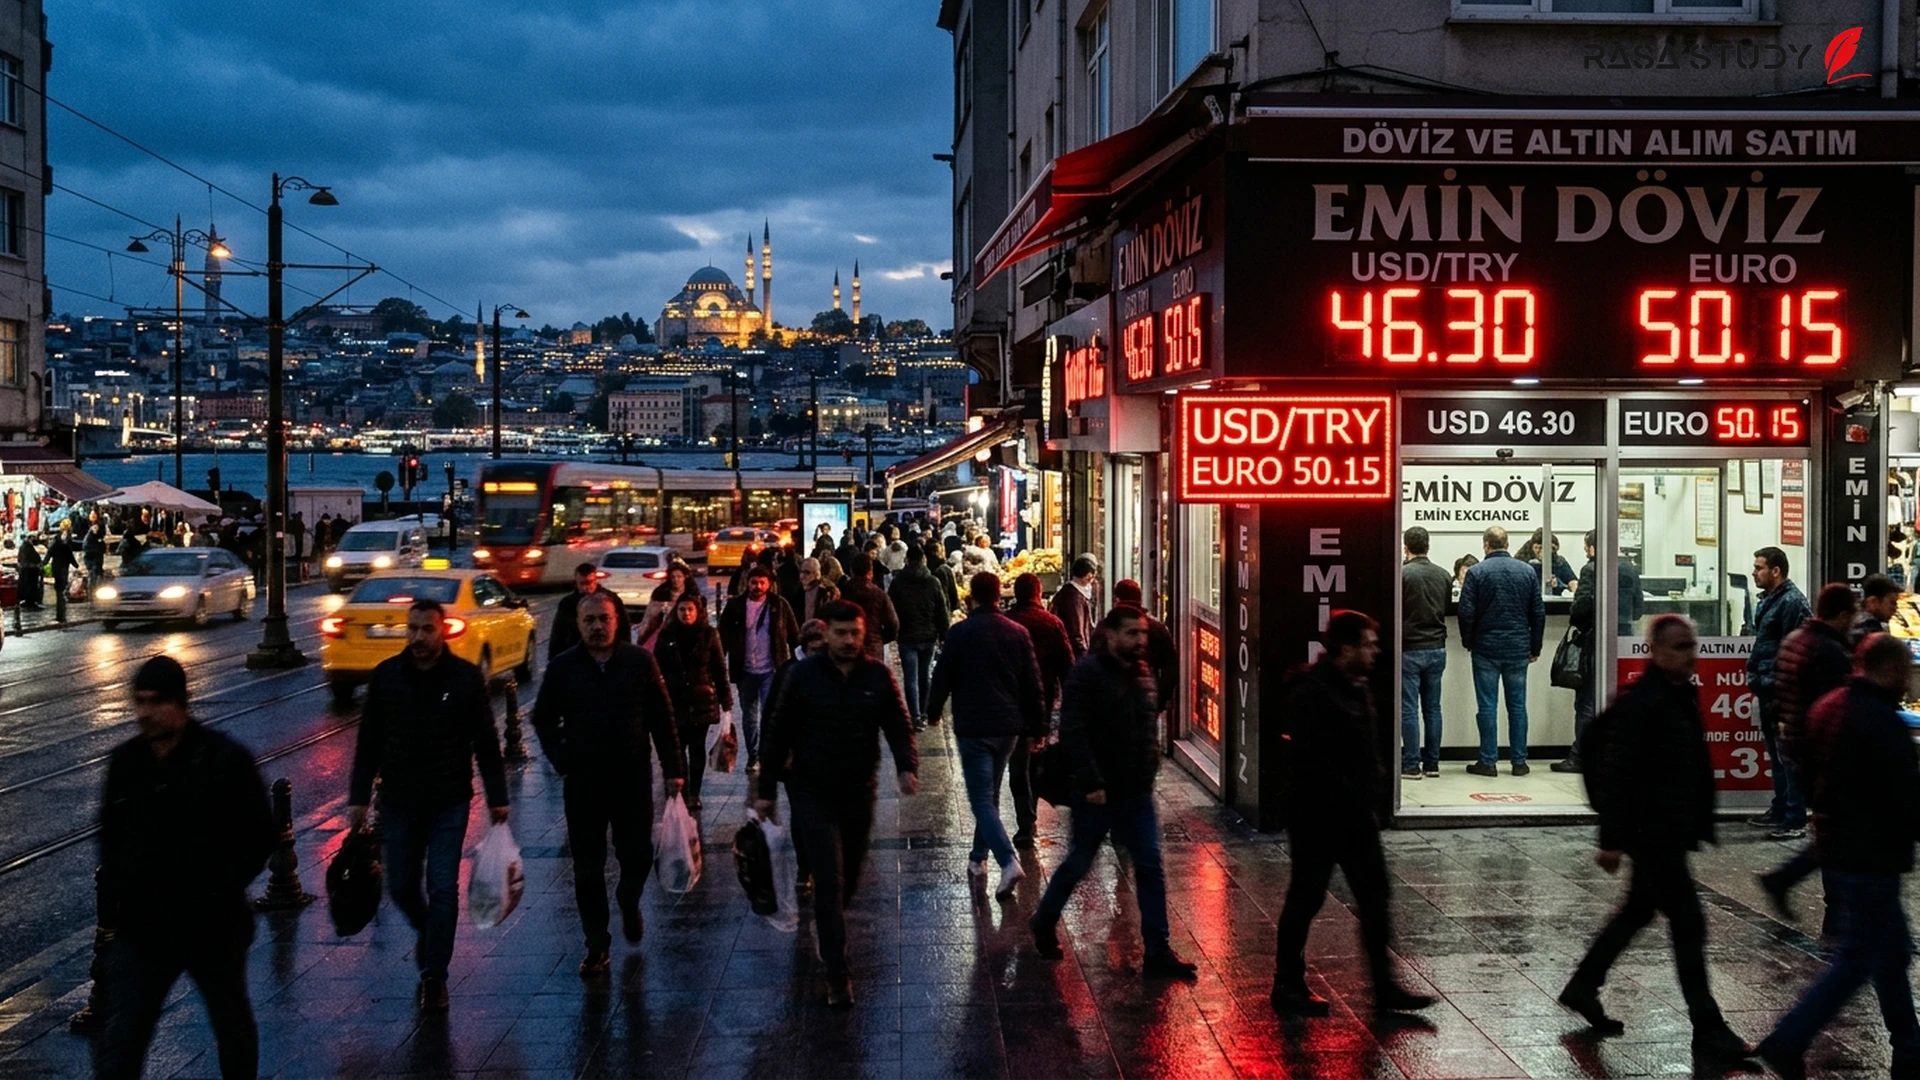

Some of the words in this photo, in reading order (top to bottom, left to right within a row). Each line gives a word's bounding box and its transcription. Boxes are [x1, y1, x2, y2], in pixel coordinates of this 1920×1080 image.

[1343, 121, 1455, 154] DÖVİZ
[1465, 128, 1513, 154] VE
[1525, 128, 1632, 155] ALTIN
[1644, 129, 1733, 155] ALIM
[1745, 129, 1857, 155] SATIM
[1312, 167, 1526, 243] EMİN
[1554, 169, 1825, 244] DÖVİZ
[1352, 252, 1519, 282] USD/TRY
[1689, 253, 1797, 283] EURO
[1331, 288, 1535, 363] 46.30
[1639, 290, 1842, 364] 50.15
[1193, 406, 1380, 451] USD/TRY
[1427, 410, 1490, 435] USD
[1498, 410, 1576, 435] 46.30
[1624, 411, 1709, 436] EURO
[1717, 408, 1799, 438] 50.15
[1193, 456, 1283, 485] EURO
[1293, 456, 1380, 485] 50.15
[1415, 507, 1451, 521] EMİN
[1454, 509, 1530, 521] EXCHANGE
[1700, 643, 1735, 654] ALTIN
[1738, 643, 1752, 654] AL
